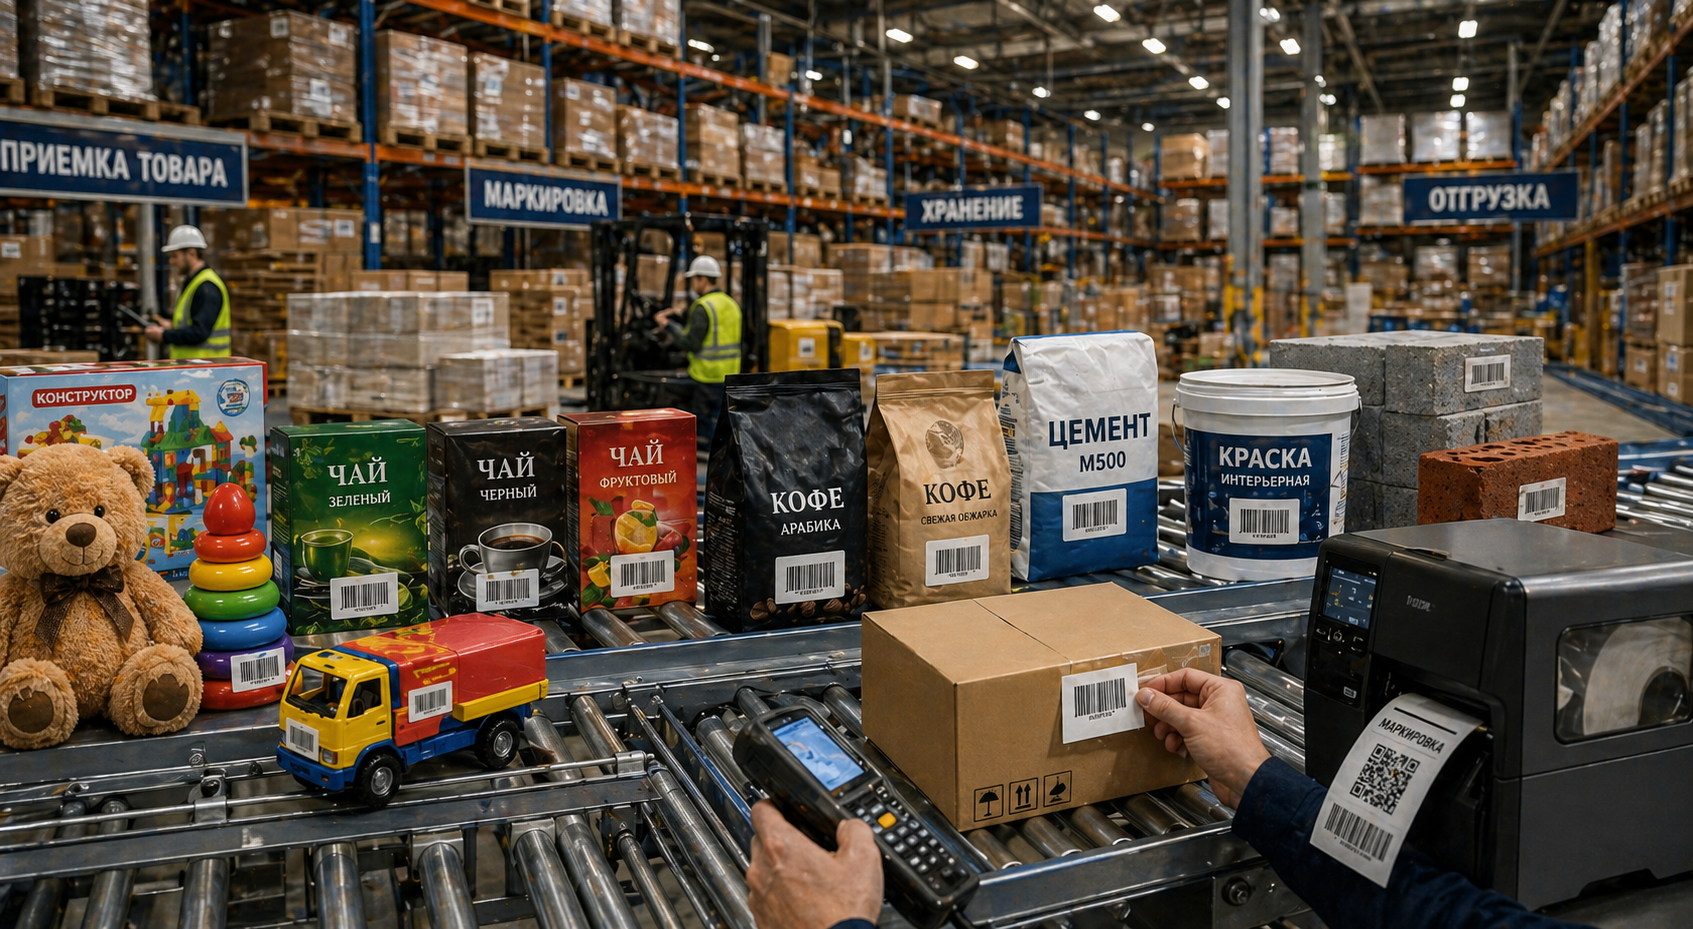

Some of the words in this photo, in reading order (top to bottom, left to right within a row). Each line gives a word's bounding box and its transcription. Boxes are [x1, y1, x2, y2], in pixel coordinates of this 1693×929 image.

[1, 140, 130, 181] ПРИЕМКА
[137, 152, 228, 188] ТОВАРА
[484, 179, 609, 217] МАРКИРОВКА
[921, 195, 1024, 224] ХРАНЕНИЕ
[1428, 183, 1551, 213] ОТГРУЗКА
[36, 389, 133, 404] КОНСТРУКТОР
[1049, 412, 1151, 450] ЦЕМЕНТ
[476, 450, 536, 480] ЧАЙ
[608, 438, 664, 468] ЧАЙ
[1079, 451, 1126, 473] М500
[1219, 446, 1313, 470] КРАСКА
[327, 456, 388, 487] ЧАЙ
[599, 470, 677, 489] ФРУКТОВЫЙ
[1221, 473, 1310, 488] ИНТЕРЬЕРНАЯ
[328, 489, 391, 508] ЗЕЛЕНЫЙ
[480, 483, 537, 501] ЧЕРНЫЙ
[770, 487, 845, 515] КОФЕ
[923, 479, 992, 505] КОФЕ
[781, 518, 842, 536] АРАБИКА
[921, 514, 956, 526] СВЕЖАЯ
[958, 509, 998, 522] ОБЖАРКА
[1378, 717, 1446, 755] МАРКИРОВКА
